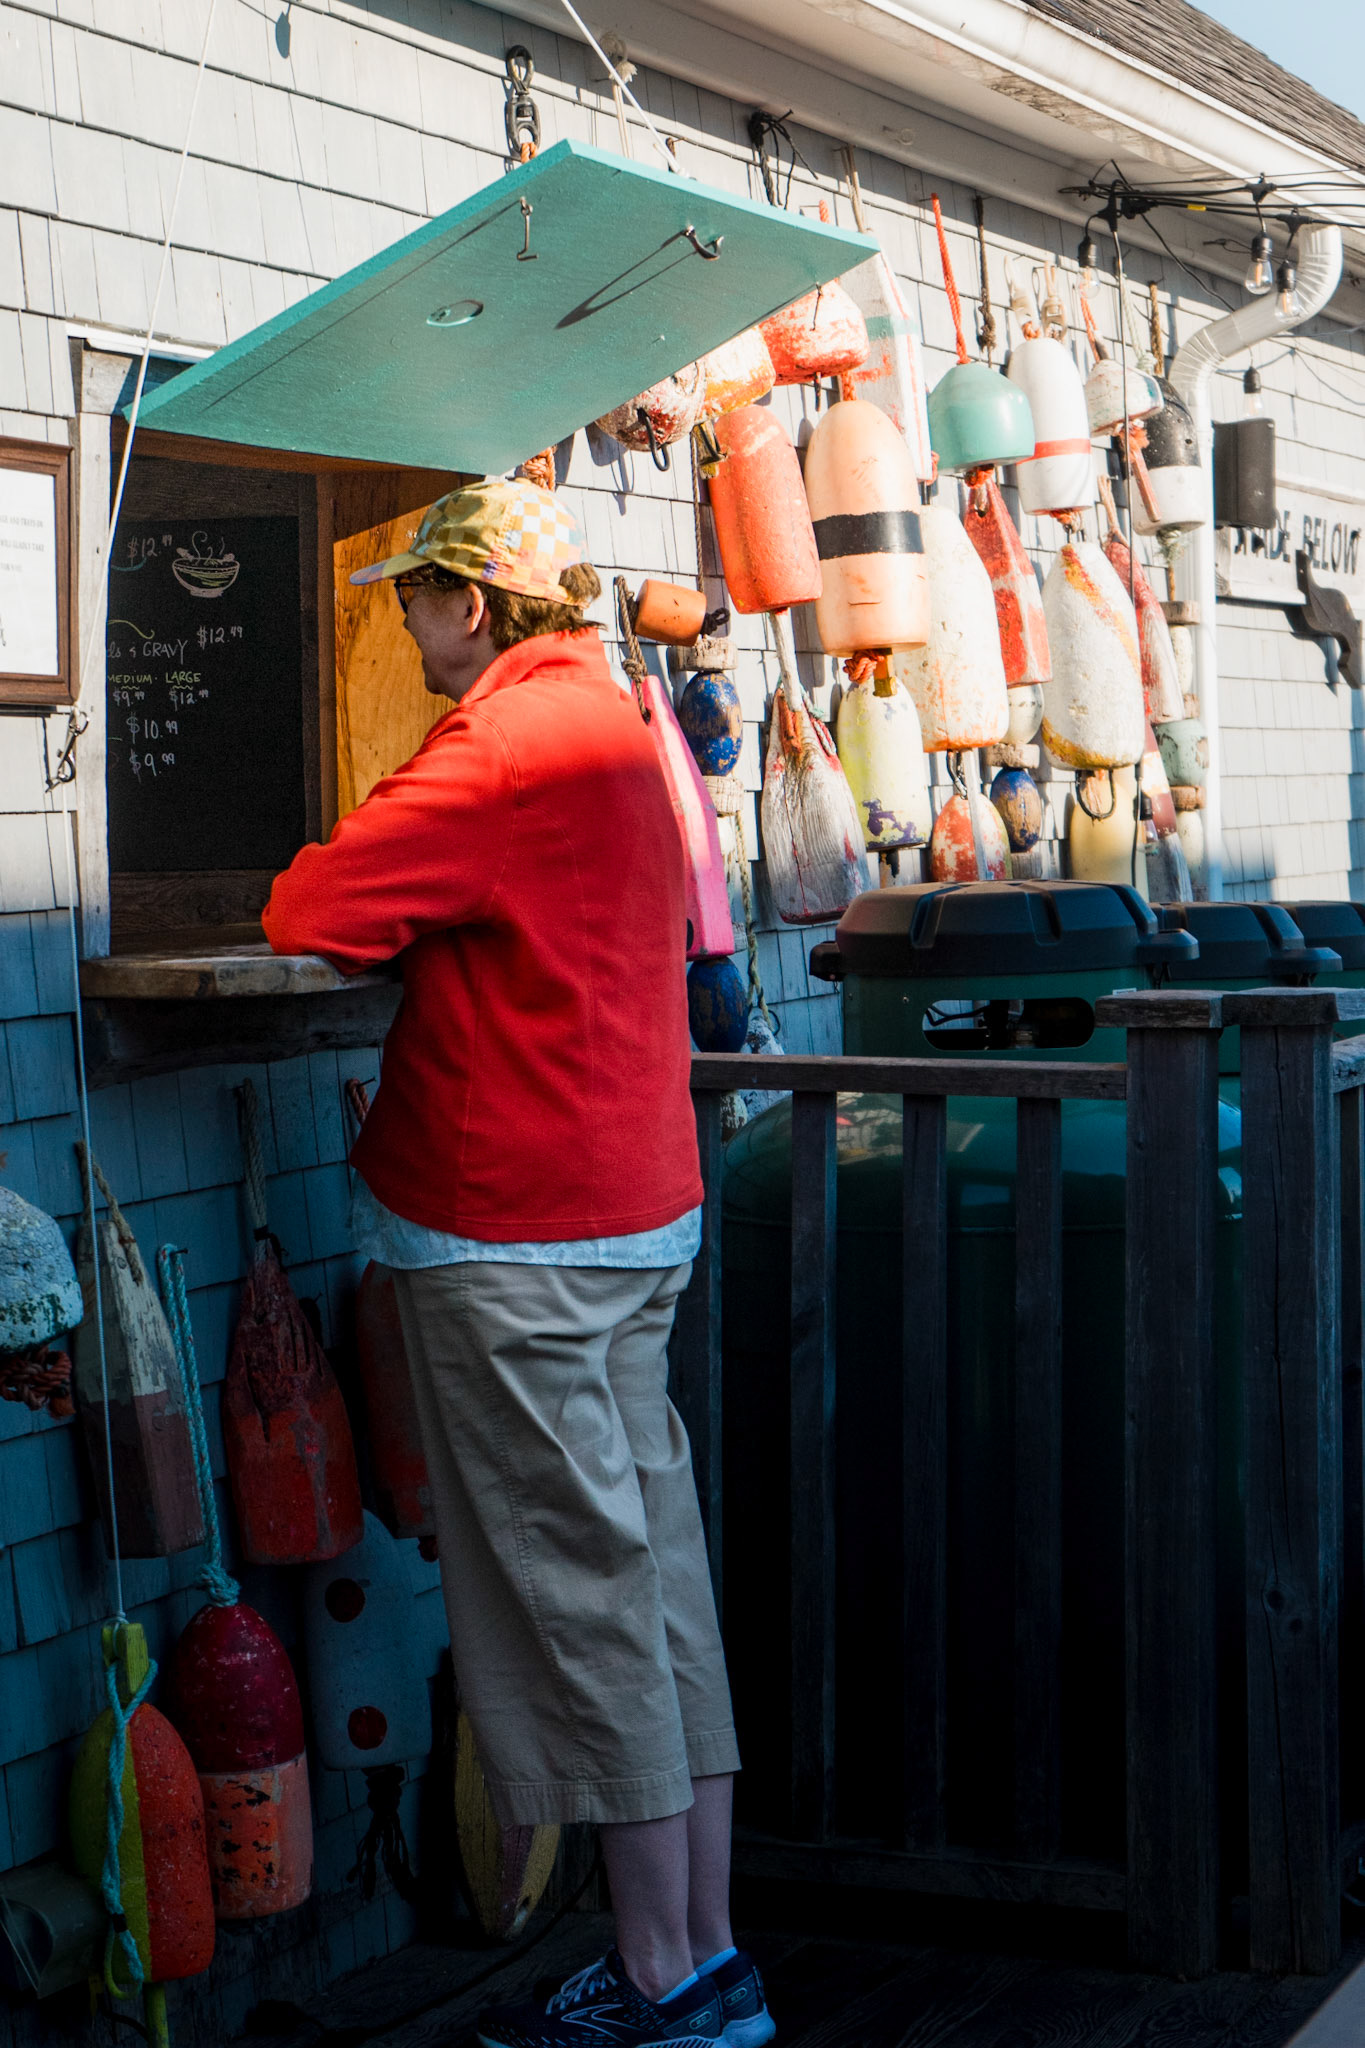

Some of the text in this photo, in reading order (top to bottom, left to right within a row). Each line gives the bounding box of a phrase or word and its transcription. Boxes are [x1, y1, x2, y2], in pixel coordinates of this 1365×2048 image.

[1303, 514, 1359, 575] BELOW
[142, 639, 188, 665] GRAVY
[196, 625, 243, 650] $12.49
[165, 671, 201, 685] LARGE
[126, 711, 179, 744] $10.99
[129, 748, 175, 784] $9.99
